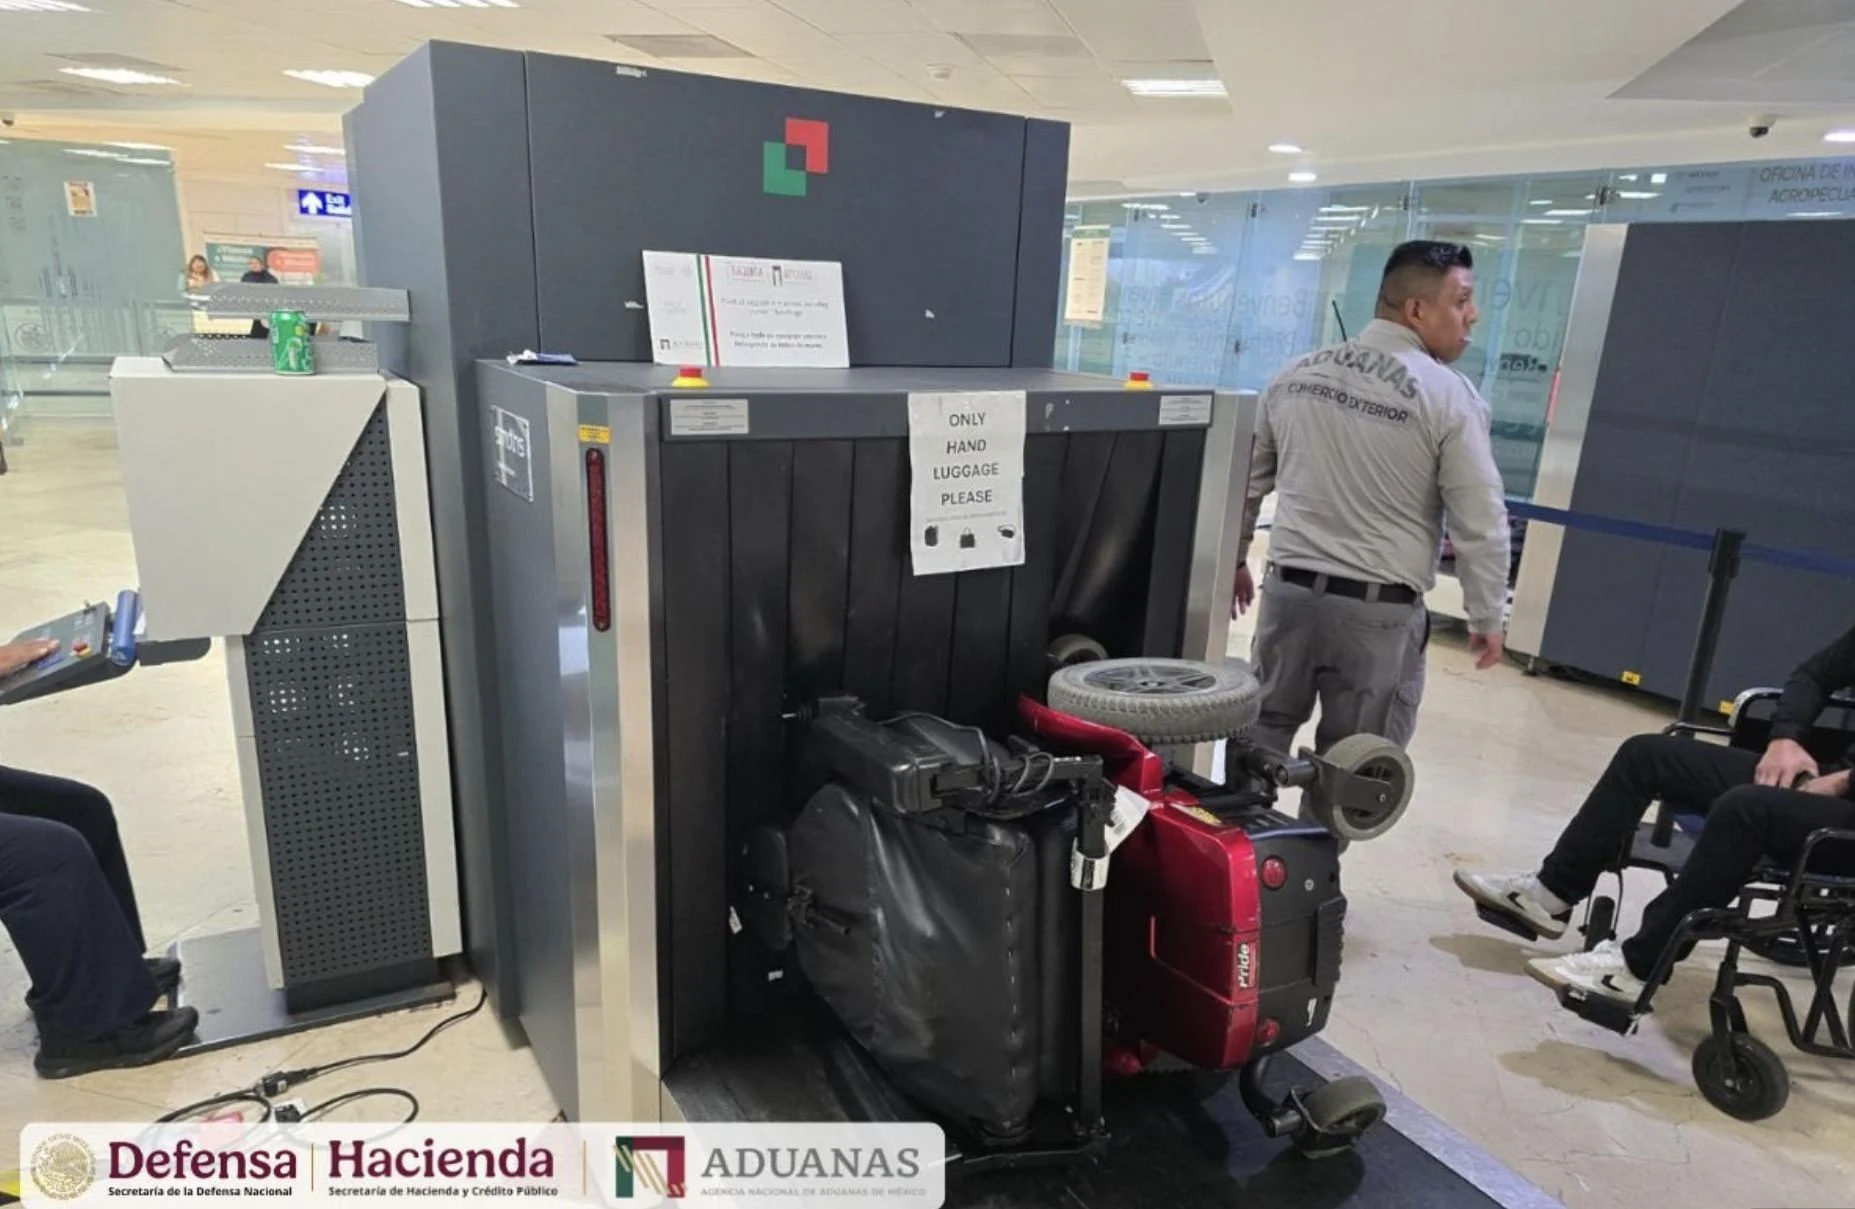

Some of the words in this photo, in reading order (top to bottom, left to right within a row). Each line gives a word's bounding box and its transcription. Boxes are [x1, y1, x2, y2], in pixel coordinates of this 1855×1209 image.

[1820, 163, 1841, 180] DE
[949, 412, 986, 427] ONLY
[946, 439, 987, 454] HAND
[933, 463, 1000, 480] LUGGAGE
[941, 490, 993, 506] PLEASE
